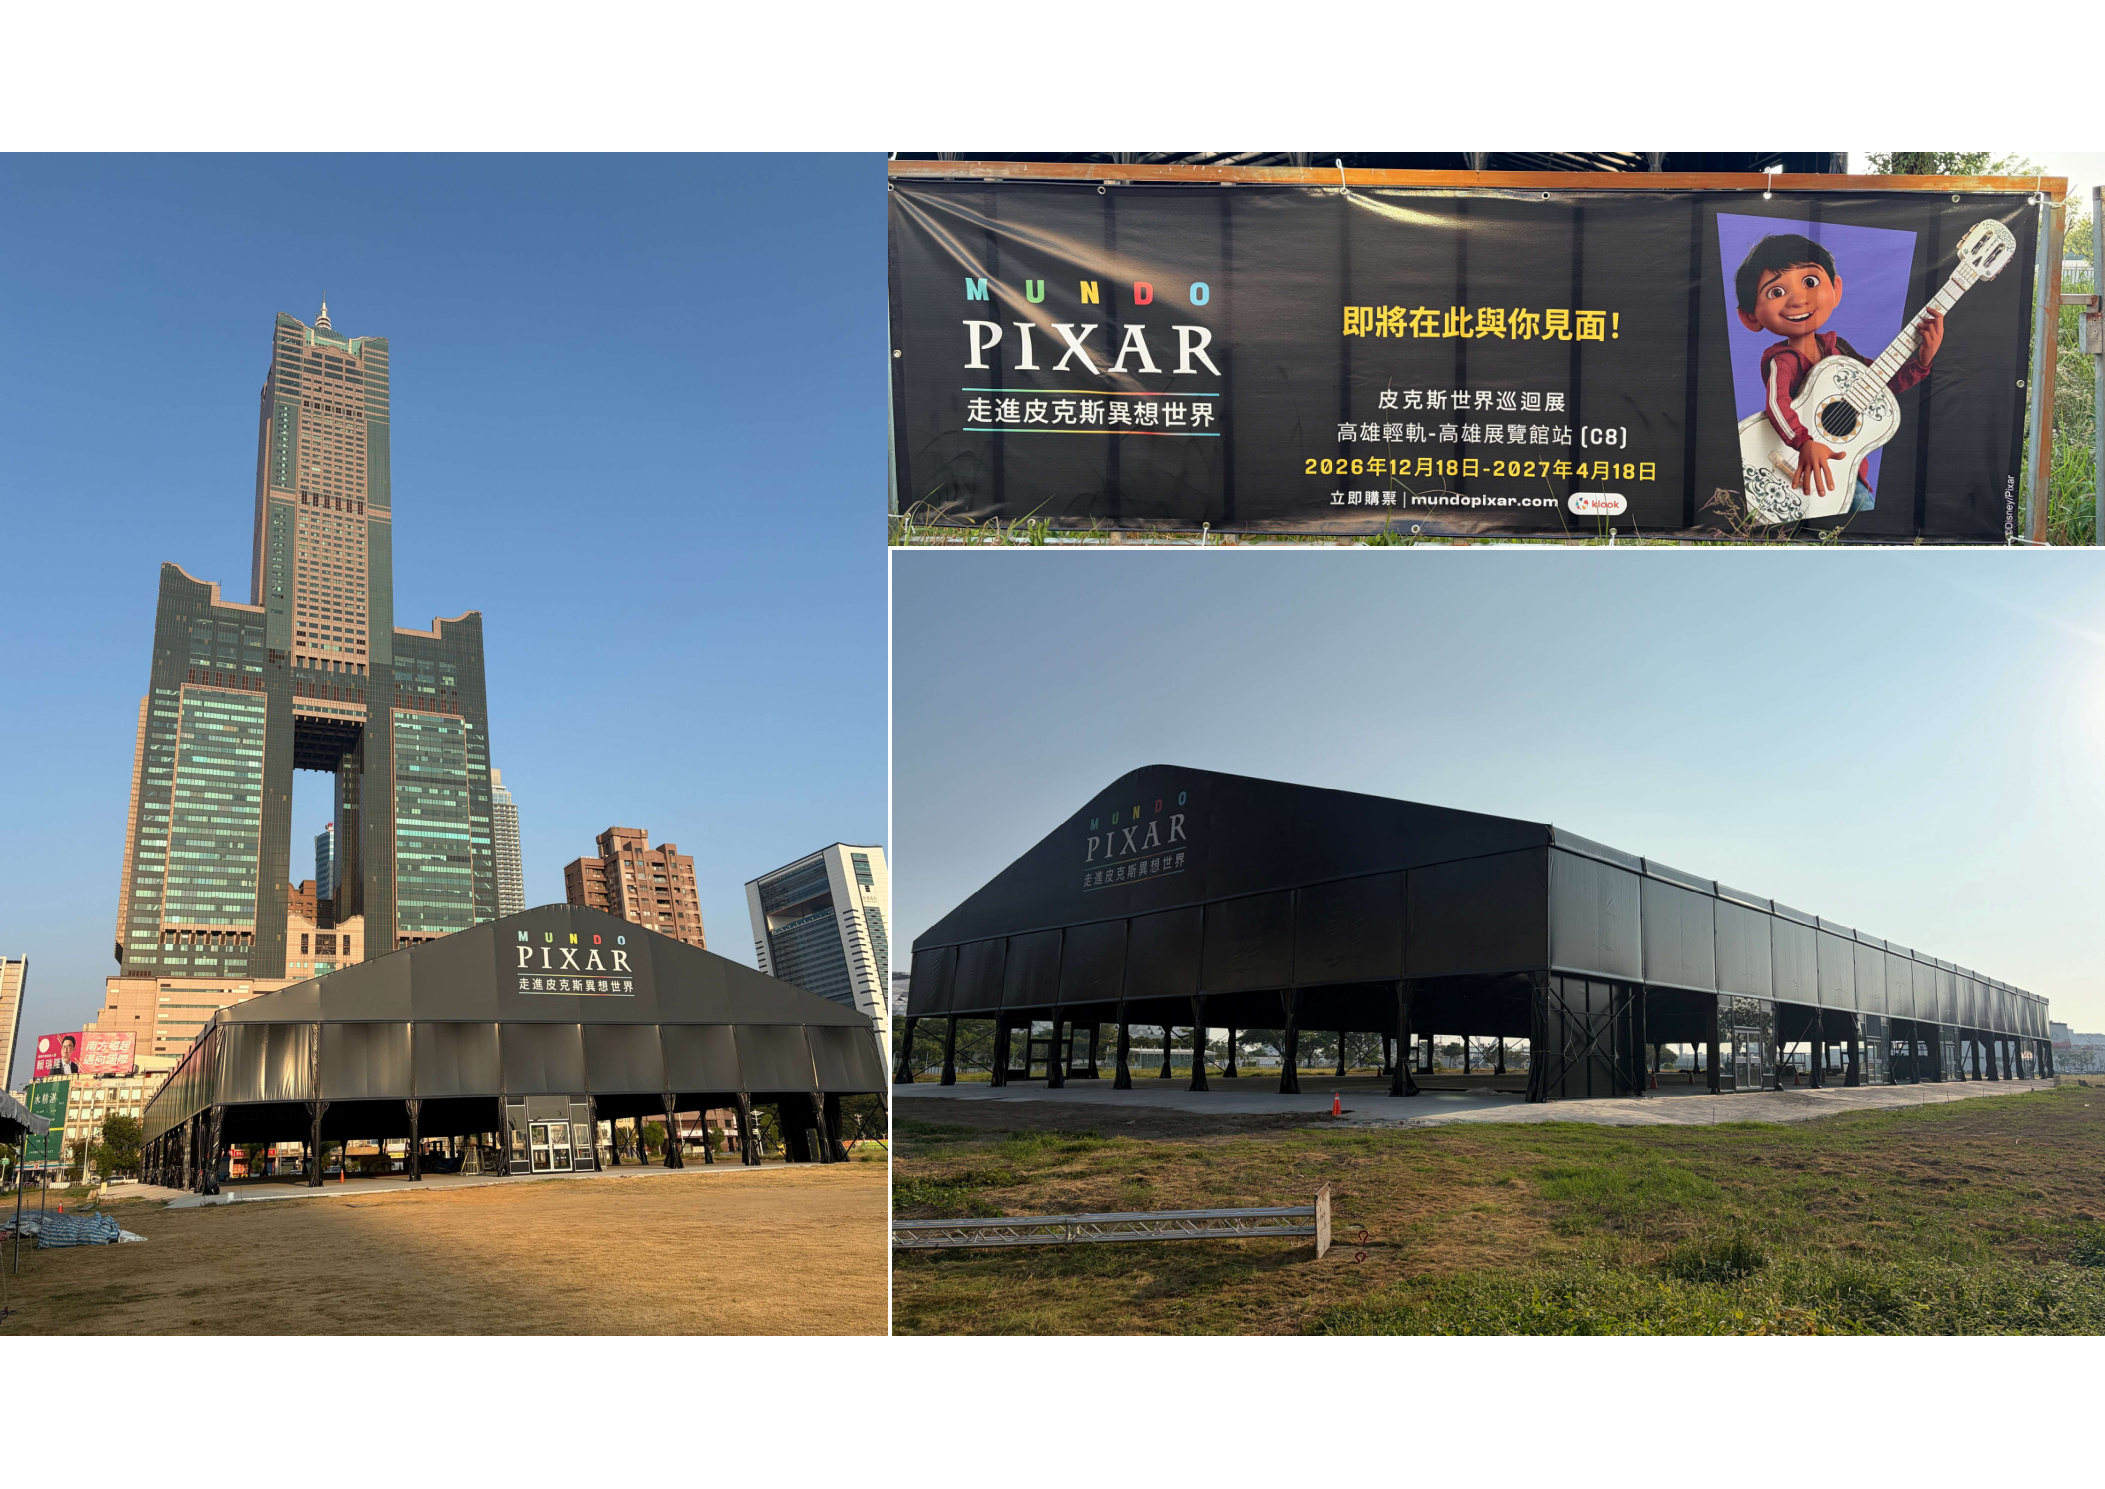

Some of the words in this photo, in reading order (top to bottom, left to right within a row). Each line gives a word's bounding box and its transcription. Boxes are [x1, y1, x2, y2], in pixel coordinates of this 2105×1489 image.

[965, 277, 1210, 306] MUNDO
[962, 320, 1222, 376] PIXAR
[967, 397, 1216, 428] 走進皮克斯異想世界
[1378, 389, 1566, 412] 皮克斯世界巡迴展
[1337, 422, 1573, 446] 高雄輕軌-高雄展覽館站
[1305, 456, 1656, 482] 2026年12月18日-2027年4月18日
[1330, 490, 1397, 507] 立即購票
[1411, 493, 1559, 509] mundopixar.com
[1591, 500, 1620, 509] klook
[1090, 791, 1187, 831] MUNDO
[1085, 813, 1187, 863] PIXAR
[1083, 852, 1185, 888] 走進皮克斯異想世界
[518, 931, 626, 945] MUNDO
[516, 945, 632, 972] PIXAR
[518, 977, 634, 993] 走進皮克斯異想世界
